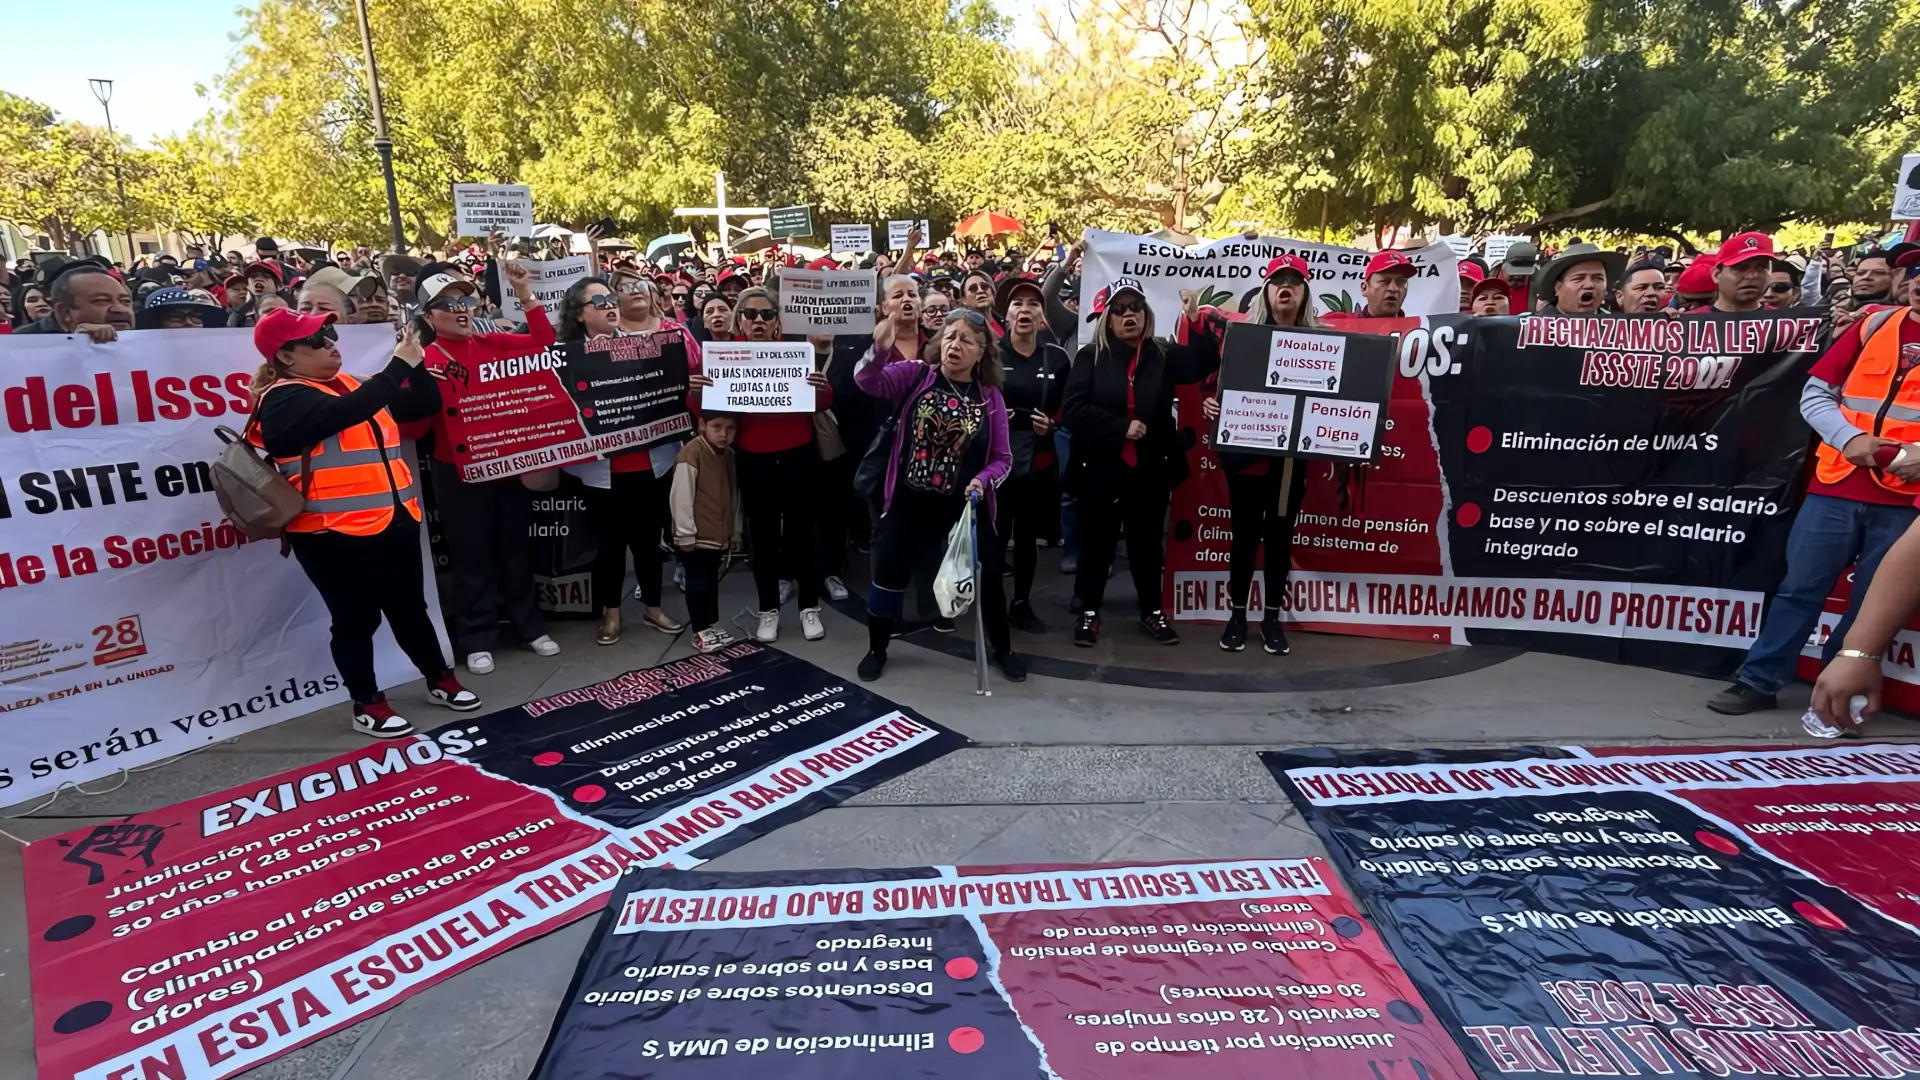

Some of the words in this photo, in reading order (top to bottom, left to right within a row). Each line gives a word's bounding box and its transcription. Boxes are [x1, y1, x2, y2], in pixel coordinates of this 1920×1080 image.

[1138, 243, 1216, 260] ESCUELA
[1337, 254, 1425, 267] GENAL
[1122, 261, 1160, 276] LUIS
[1165, 263, 1252, 279] DONALDO
[1517, 316, 1683, 354] ¡RECHAZAMOS
[1688, 320, 1718, 354] LA
[1724, 319, 1772, 354] LEY
[1773, 318, 1821, 353] DEL
[479, 349, 568, 383] EXIGIMOS:
[756, 351, 769, 359] LEY
[770, 351, 783, 359] DEL
[708, 368, 719, 379] NO
[743, 367, 802, 378] INCREMENTOS
[1580, 351, 1662, 389] ISSSTE
[730, 382, 763, 393] CUOTAS
[765, 383, 771, 392] A
[773, 383, 789, 393] LOS
[4, 371, 119, 433] del
[134, 370, 253, 425] Isss
[727, 396, 792, 407] TRABAJADORES
[1311, 402, 1371, 420] Pensión
[486, 463, 512, 477] ESTA
[513, 453, 557, 471] ESCUELA
[557, 435, 624, 460] TRABAJAMOS
[625, 430, 649, 444] BAJO
[650, 416, 692, 438] PROTESTA!
[1316, 426, 1359, 443] Digna
[1501, 433, 1618, 452] Eliminación
[1622, 434, 1648, 451] de
[19, 461, 148, 515] SNTE
[154, 463, 214, 494] en
[1493, 488, 1607, 506] Descuentos
[1611, 489, 1669, 508] sobre
[1673, 493, 1694, 510] el
[1697, 493, 1778, 516] salario
[1342, 514, 1361, 528] de
[1364, 517, 1429, 534] pensión
[1489, 513, 1535, 530] base
[1539, 515, 1552, 533] y
[1554, 517, 1580, 532] no
[1584, 517, 1640, 535] sobre
[1643, 519, 1664, 536] el
[1667, 521, 1746, 544] salario
[1313, 535, 1375, 551] sistema
[1379, 538, 1399, 553] de
[1484, 537, 1579, 560] integrado
[0, 552, 46, 590] de
[52, 544, 99, 579] la
[1175, 580, 1208, 614] ¡EN
[1215, 581, 1263, 613] ESA
[1281, 580, 1360, 614] SCUELA
[1366, 581, 1525, 620] TRABAJAMOS
[1533, 588, 1600, 625] BAJO
[1609, 592, 1761, 638] PROTESTA!
[92, 620, 139, 652] 28
[48, 685, 82, 701] ESTÁ
[85, 681, 103, 691] EN
[107, 676, 124, 687] LA
[127, 664, 175, 680] UNIDAD
[570, 711, 687, 755] Eliminación
[687, 702, 711, 715] de
[29, 727, 163, 781] serán
[201, 725, 488, 838] EXIGIMOS:
[631, 760, 738, 803] integrado
[1294, 770, 1459, 799] PROTESTA!
[1449, 764, 1542, 790] BAJO
[105, 839, 262, 898] Jubilación
[268, 823, 311, 847] por
[317, 795, 405, 828] tiempo
[409, 785, 438, 799] de
[108, 869, 233, 918] servicio
[257, 848, 292, 868] 28
[296, 829, 361, 853] años
[366, 794, 471, 832] mujeres,
[112, 916, 153, 938] 30
[160, 889, 239, 920] años
[245, 837, 383, 892] hombres)
[1072, 870, 1198, 901] ESCUELA
[1198, 867, 1271, 893] ESTA
[1268, 862, 1321, 889] ¡EN
[120, 928, 260, 984] Cambio
[265, 912, 296, 932] al
[301, 864, 420, 919] régimen
[424, 854, 456, 871] de
[460, 818, 555, 860] pensión
[198, 986, 331, 1068] ESTA
[331, 898, 526, 1005] ESCUELA
[514, 799, 744, 912] TRABAJAMOS
[732, 765, 814, 825] BAJO
[801, 715, 926, 778] PROTESTA!
[787, 890, 863, 917] BAJO
[873, 877, 1070, 913] TRABAJAMOS
[620, 894, 777, 927] PROTESTA!
[1575, 909, 1615, 928] de
[1617, 907, 1796, 929] Eliminación
[127, 919, 344, 1012] (eliminación
[349, 901, 386, 921] de
[390, 855, 496, 904] sistema
[499, 845, 531, 861] de
[816, 937, 933, 952] integrado
[130, 970, 264, 1035] afores)
[1160, 982, 1273, 1004] hombres)
[1276, 984, 1333, 998] años
[1338, 984, 1366, 998] 30
[1177, 1009, 1237, 1025] años
[1241, 1009, 1270, 1023] 28
[1287, 1007, 1380, 1023] servicio
[1657, 983, 1816, 1028] ISSSTE
[1066, 1011, 1174, 1028] mujeres,
[734, 1037, 769, 1053] de
[775, 1032, 935, 1056] Eliminación
[1094, 1039, 1124, 1055] de
[1130, 1035, 1220, 1055] tiempo
[1225, 1034, 1262, 1051] por
[1273, 1032, 1395, 1052] Jubilación
[1462, 1025, 1565, 1075] DEL
[1548, 1026, 1641, 1076] LEY
[1616, 1025, 1700, 1075] LA
